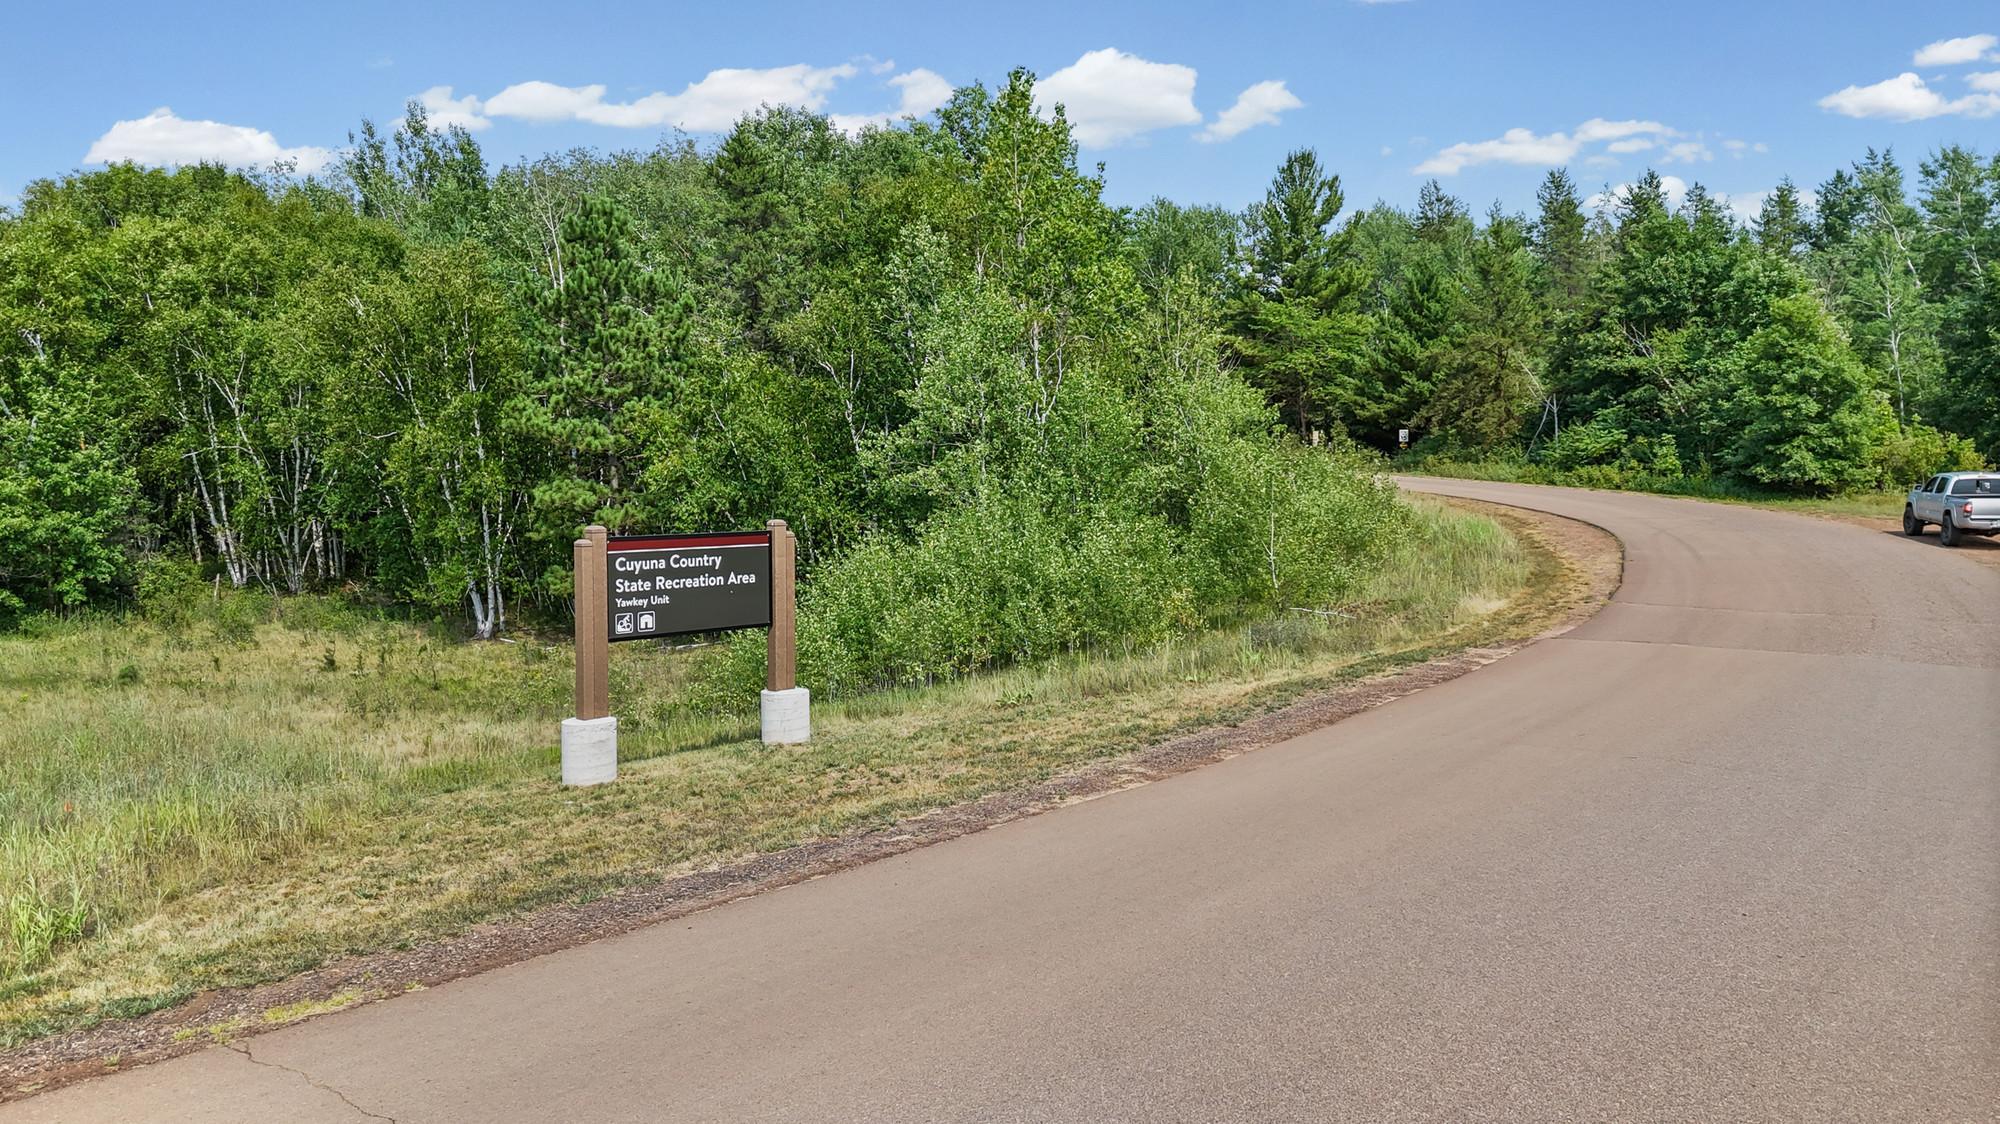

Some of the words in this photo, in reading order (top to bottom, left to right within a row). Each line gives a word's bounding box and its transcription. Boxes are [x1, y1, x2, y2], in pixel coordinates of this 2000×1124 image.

[615, 557, 666, 574] Cuyuna
[669, 554, 722, 569] Country
[615, 578, 651, 593] State
[655, 573, 724, 590] Recreation
[727, 571, 756, 585] Area
[615, 596, 648, 608] Yawkey
[650, 595, 670, 606] Unit
